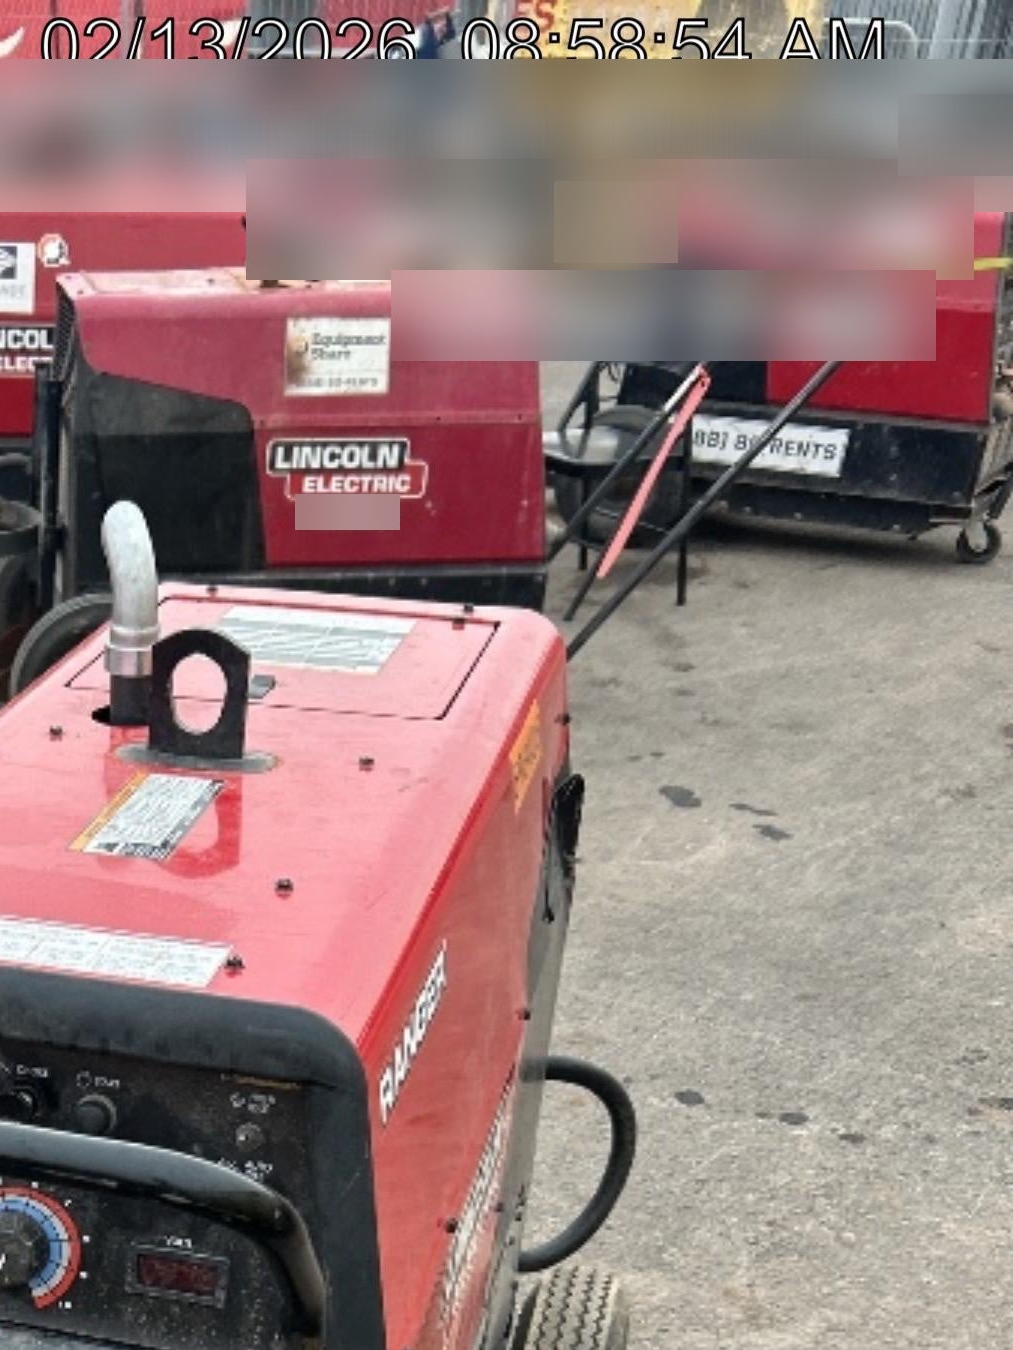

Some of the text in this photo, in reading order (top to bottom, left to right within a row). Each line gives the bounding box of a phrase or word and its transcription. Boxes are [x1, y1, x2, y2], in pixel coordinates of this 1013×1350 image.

[274, 443, 400, 469] LINCOLN
[302, 474, 412, 493] ELECTRIC
[379, 937, 447, 1126] RANGER
